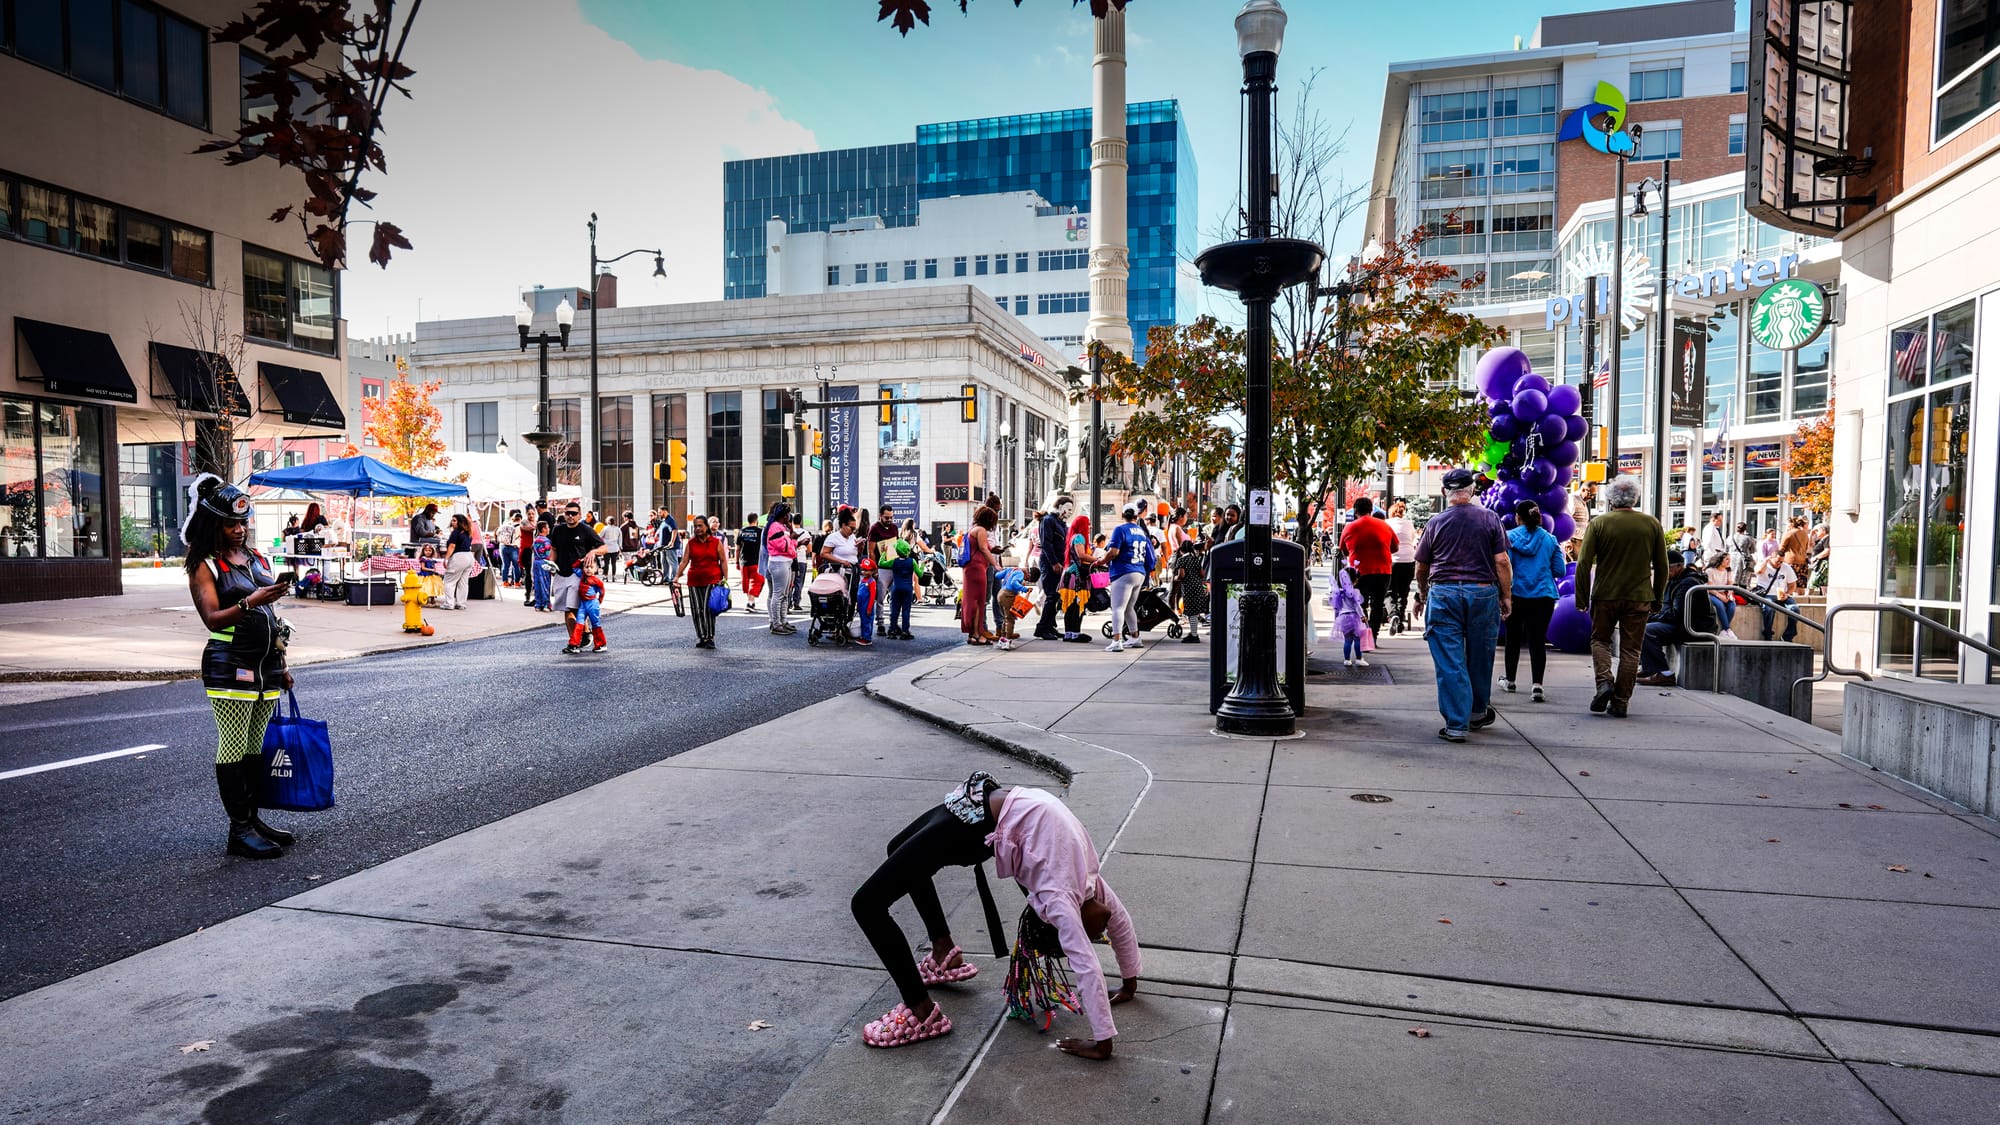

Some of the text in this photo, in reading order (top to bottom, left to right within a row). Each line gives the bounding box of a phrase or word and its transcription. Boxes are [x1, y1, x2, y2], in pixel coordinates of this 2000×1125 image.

[1666, 253, 1798, 299] enter
[645, 370, 805, 388] MERCHANTS NATIONAL BANK
[1712, 454, 1734, 462] NWS
[271, 769, 292, 778] ALDI
